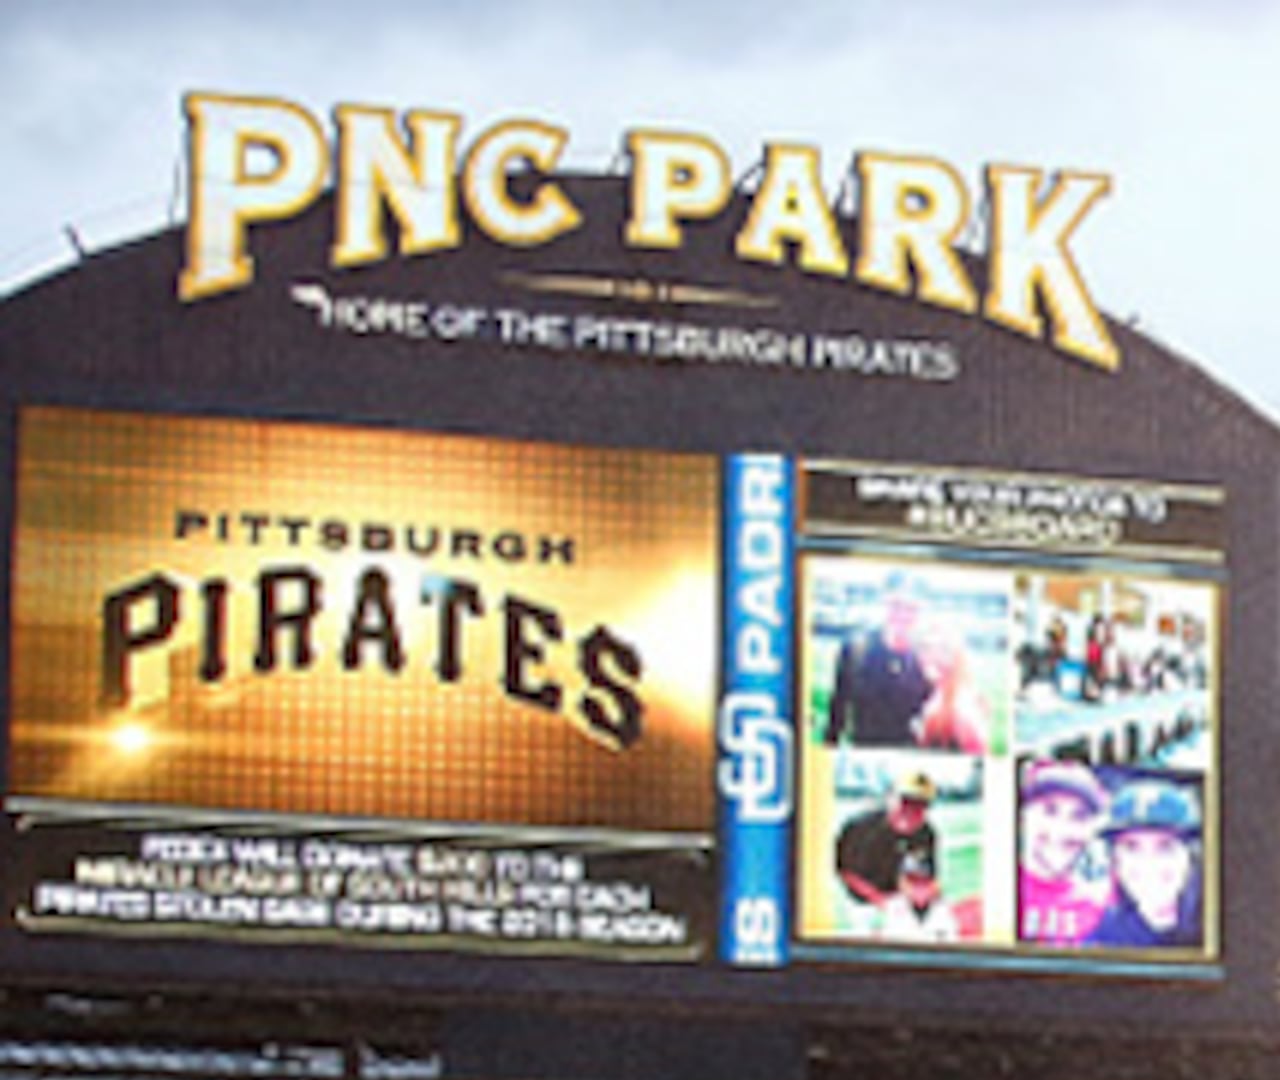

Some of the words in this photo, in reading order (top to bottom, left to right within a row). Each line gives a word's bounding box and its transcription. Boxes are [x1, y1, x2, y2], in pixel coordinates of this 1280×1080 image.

[178, 90, 580, 302] PNC
[624, 128, 1122, 372] PARK
[319, 299, 428, 338] HOME
[432, 305, 486, 339] OF
[499, 309, 567, 347] THE
[813, 341, 959, 381] PIRATES
[173, 508, 578, 566] PITTSBURGH
[101, 562, 645, 750] PIRATES
